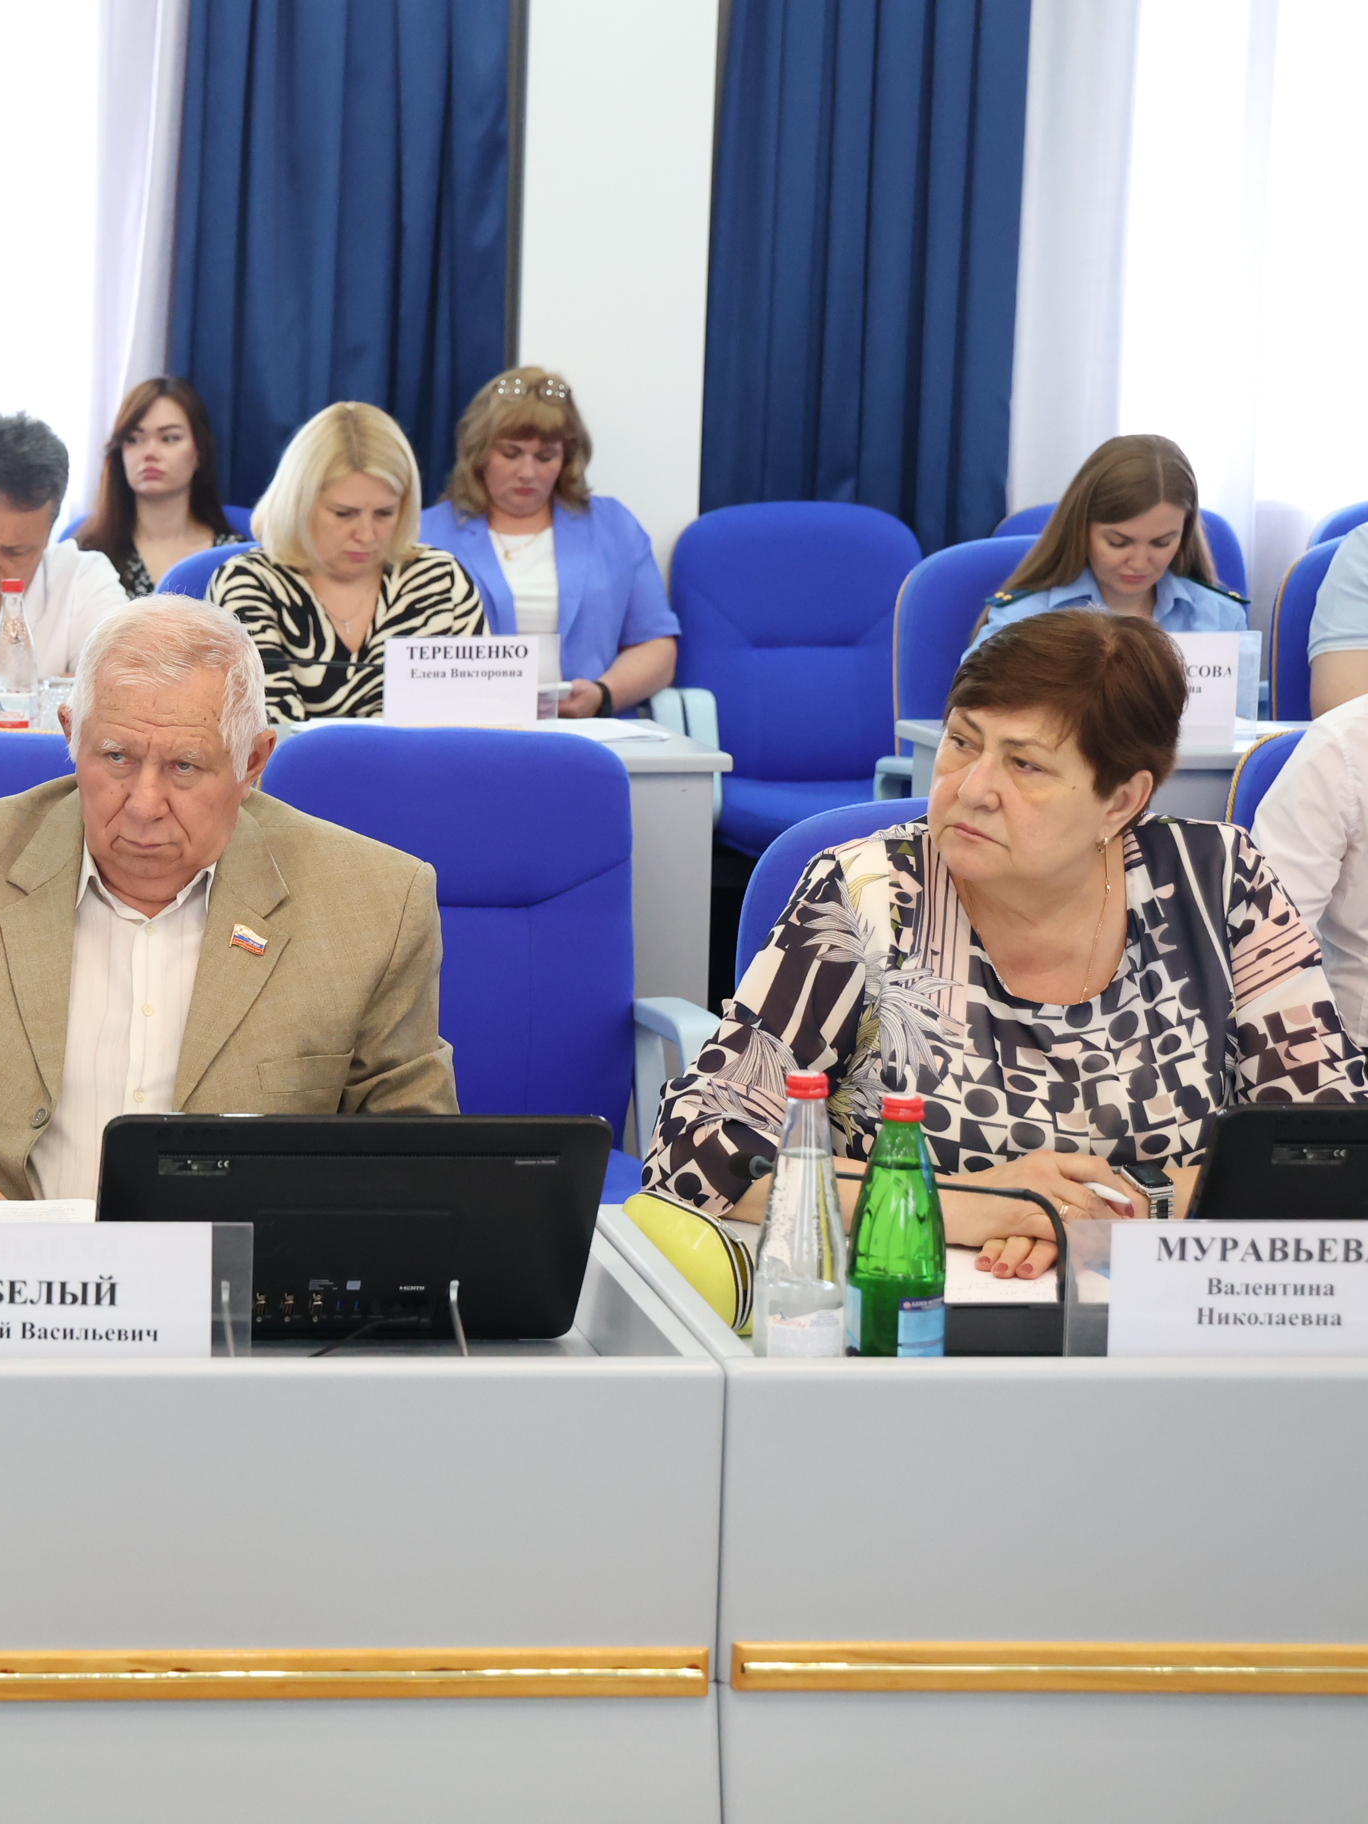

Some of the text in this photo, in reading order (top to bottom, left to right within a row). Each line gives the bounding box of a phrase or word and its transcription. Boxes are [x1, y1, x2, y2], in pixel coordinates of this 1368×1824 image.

[406, 644, 529, 662] ТЕРЕЩЕНКО
[409, 667, 523, 681] Елена Викторовна
[1156, 1236, 1368, 1265] МУРАВЬЕВ
[1207, 1276, 1336, 1297] Валентина
[1196, 1306, 1343, 1328] Николаевна
[20, 1320, 160, 1343] Васильевич
